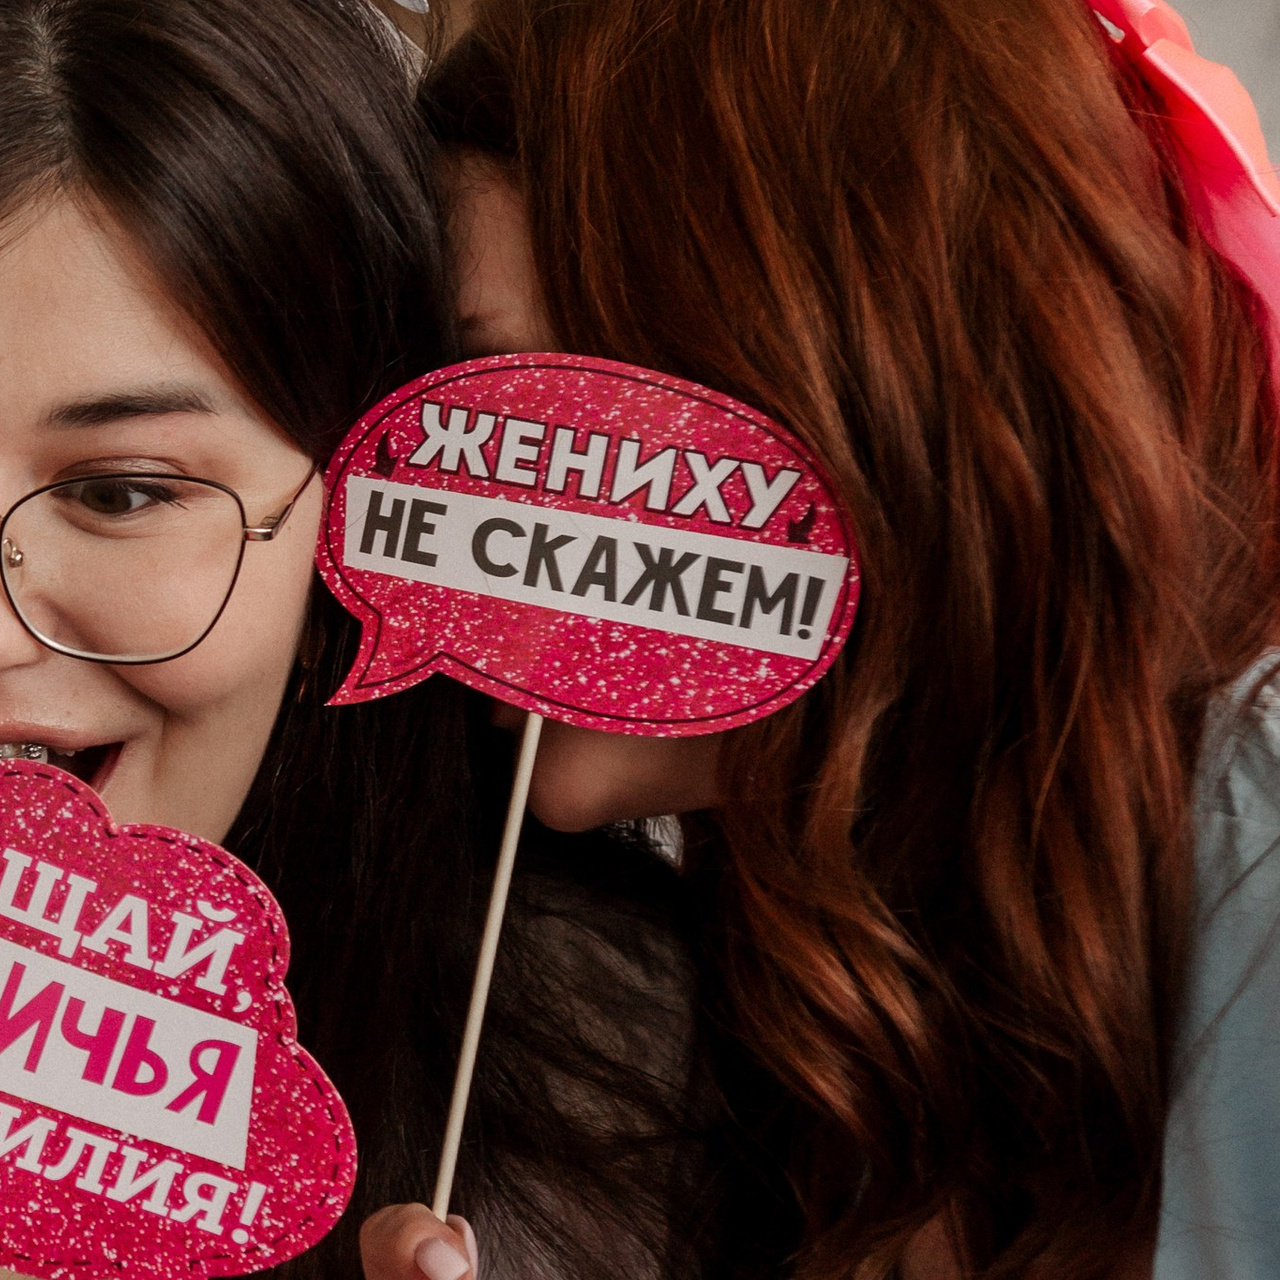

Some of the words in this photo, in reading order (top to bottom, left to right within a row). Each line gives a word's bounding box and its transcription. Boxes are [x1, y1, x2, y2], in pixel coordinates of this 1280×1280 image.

[408, 402, 801, 529] ЖЕНИХУ
[358, 490, 448, 568] НЕ
[470, 517, 826, 641] СКАЖЕМ!
